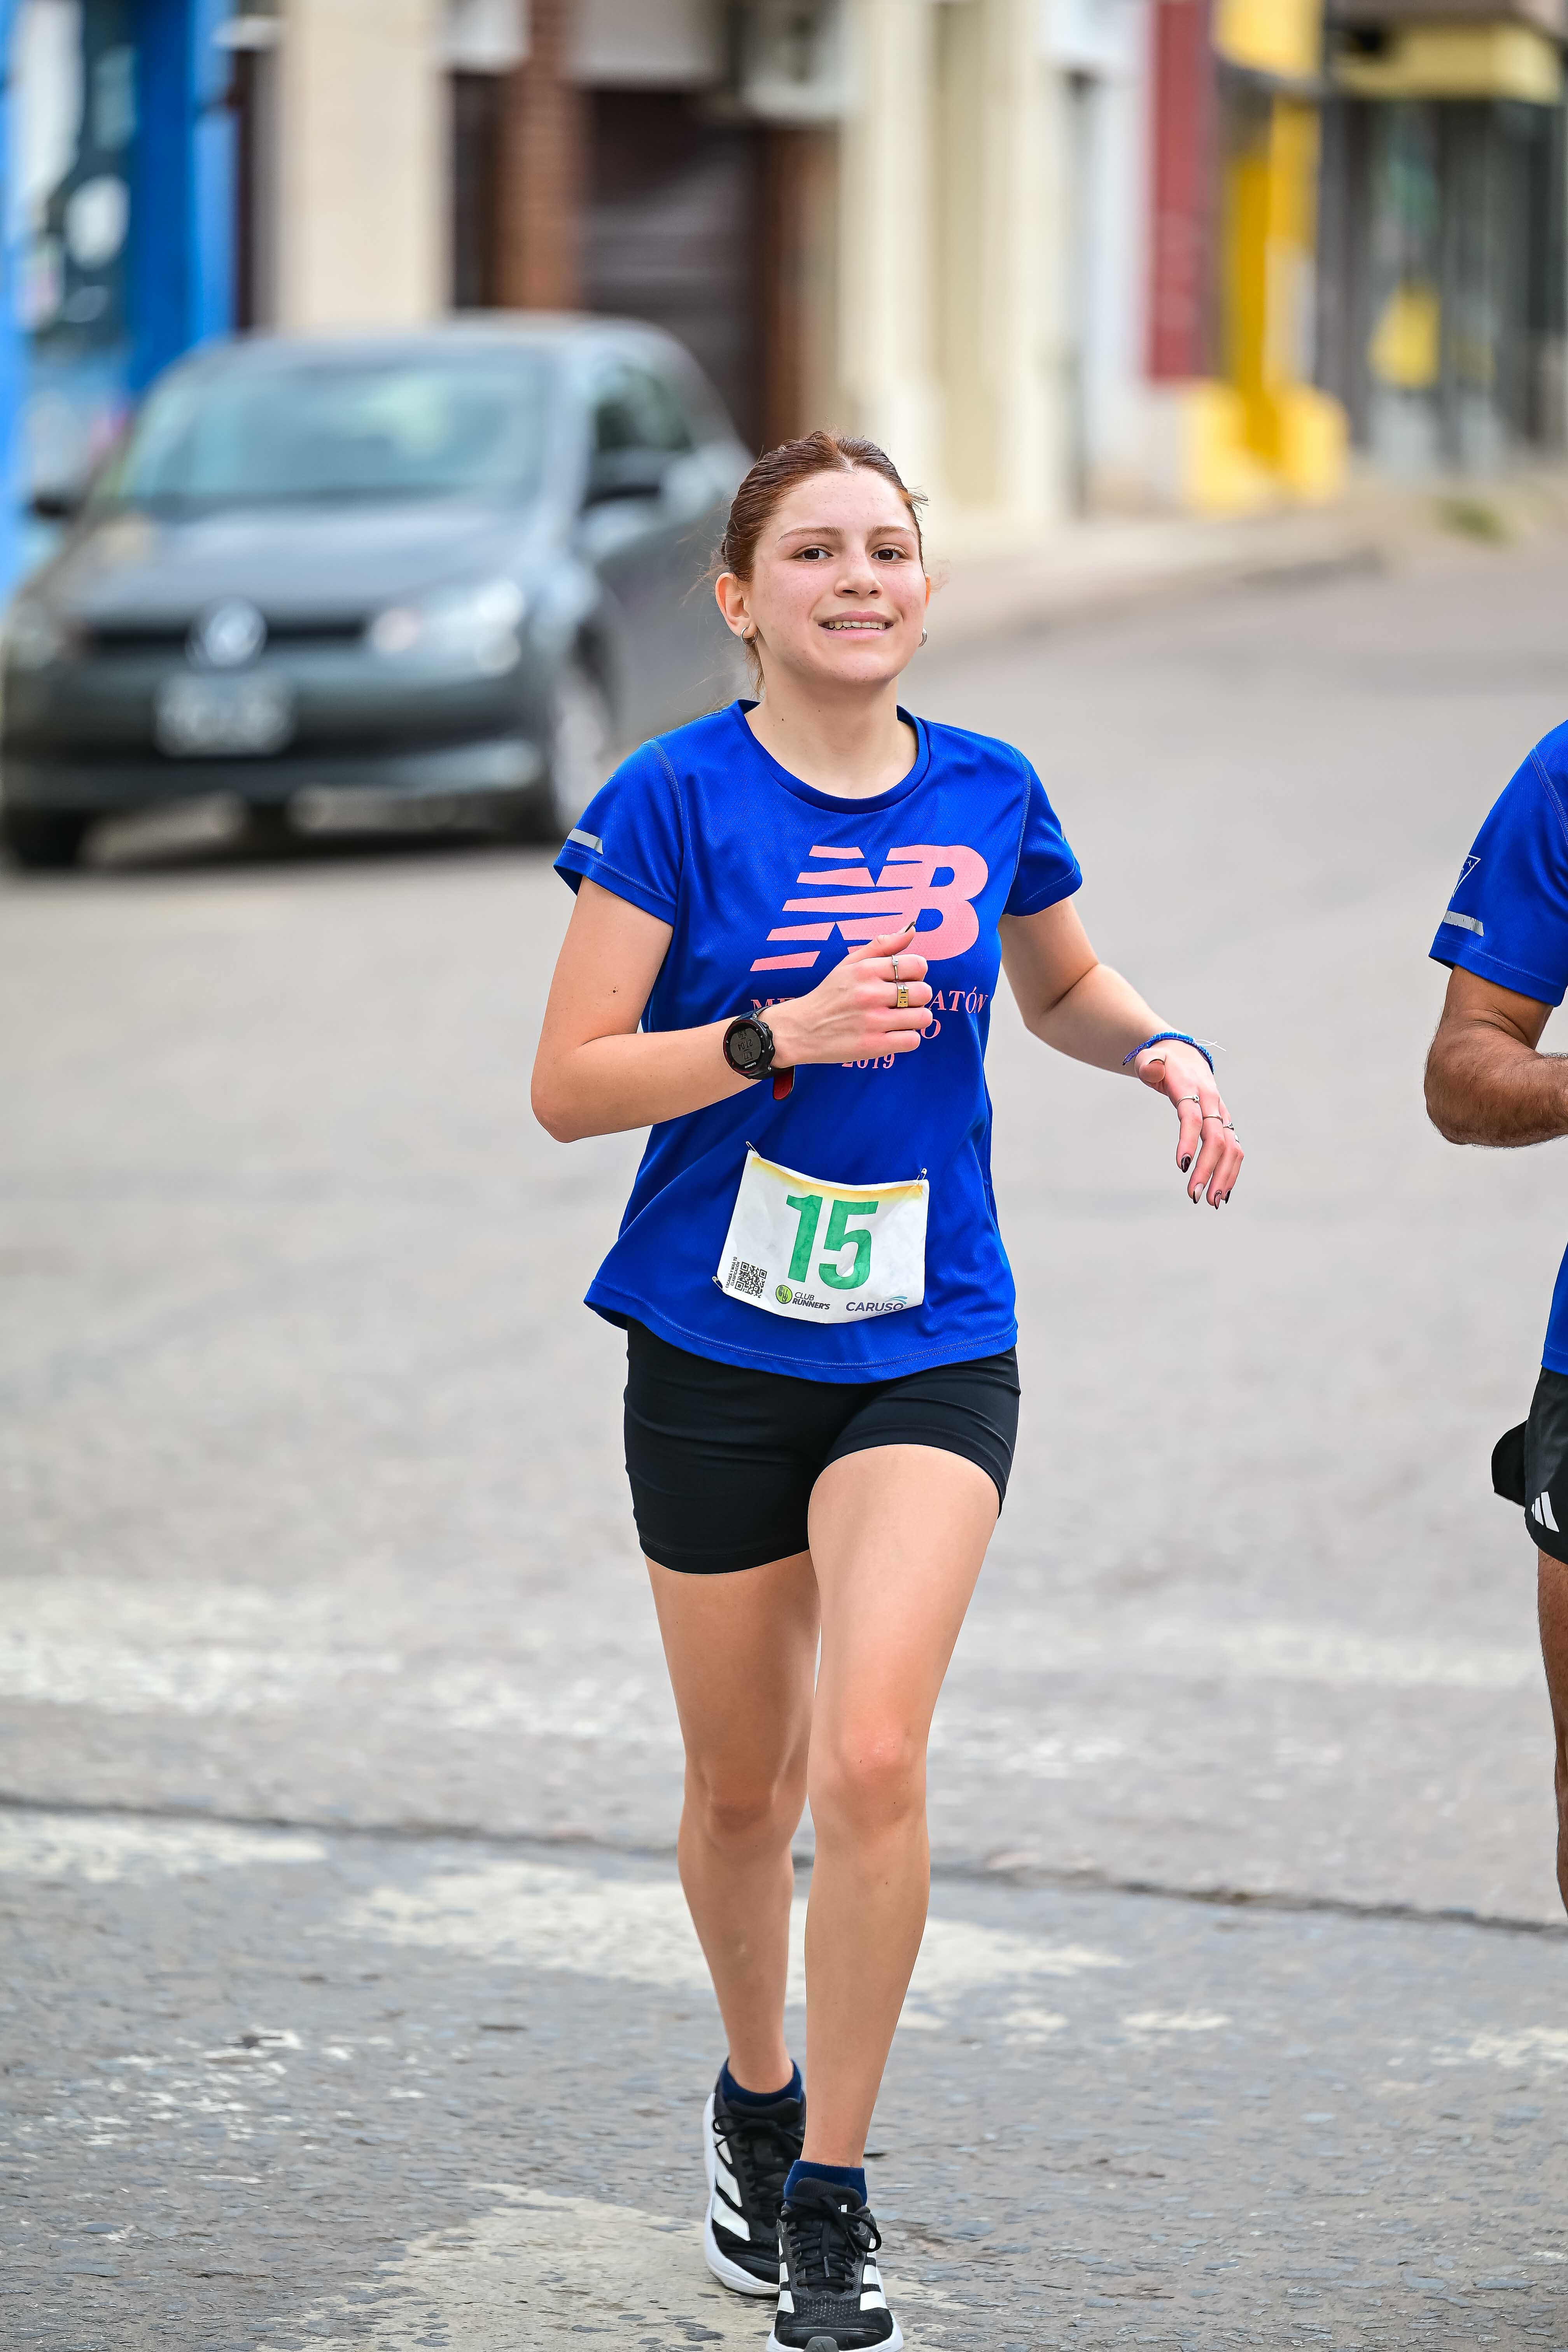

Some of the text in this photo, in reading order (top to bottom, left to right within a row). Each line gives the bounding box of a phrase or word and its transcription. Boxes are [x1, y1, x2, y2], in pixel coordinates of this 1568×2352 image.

[786, 1194, 879, 1290] 15
[794, 1292, 815, 1300] CLUB
[792, 1298, 831, 1310] RUNNER'S
[846, 1302, 904, 1312] CARUSO
